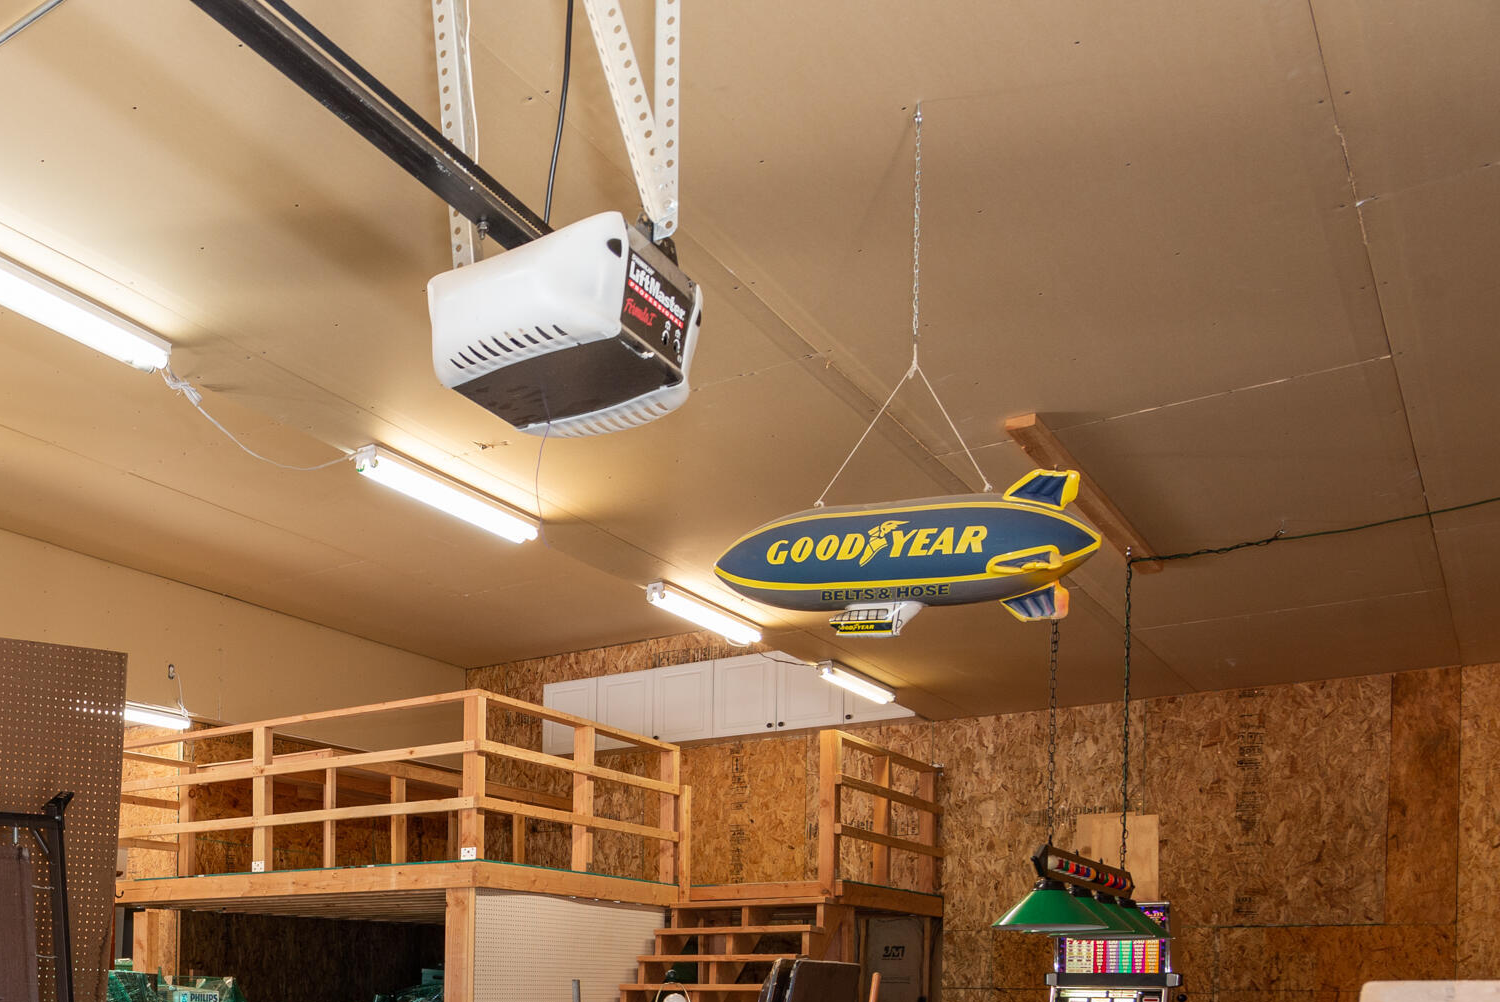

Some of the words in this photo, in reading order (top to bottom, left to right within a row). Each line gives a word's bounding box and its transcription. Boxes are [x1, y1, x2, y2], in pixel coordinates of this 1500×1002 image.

[629, 260, 686, 321] LiftMaster
[821, 589, 874, 601] BELTS
[879, 588, 892, 600] &
[896, 585, 950, 599] HOSE
[190, 993, 218, 1002] PHILIPS
